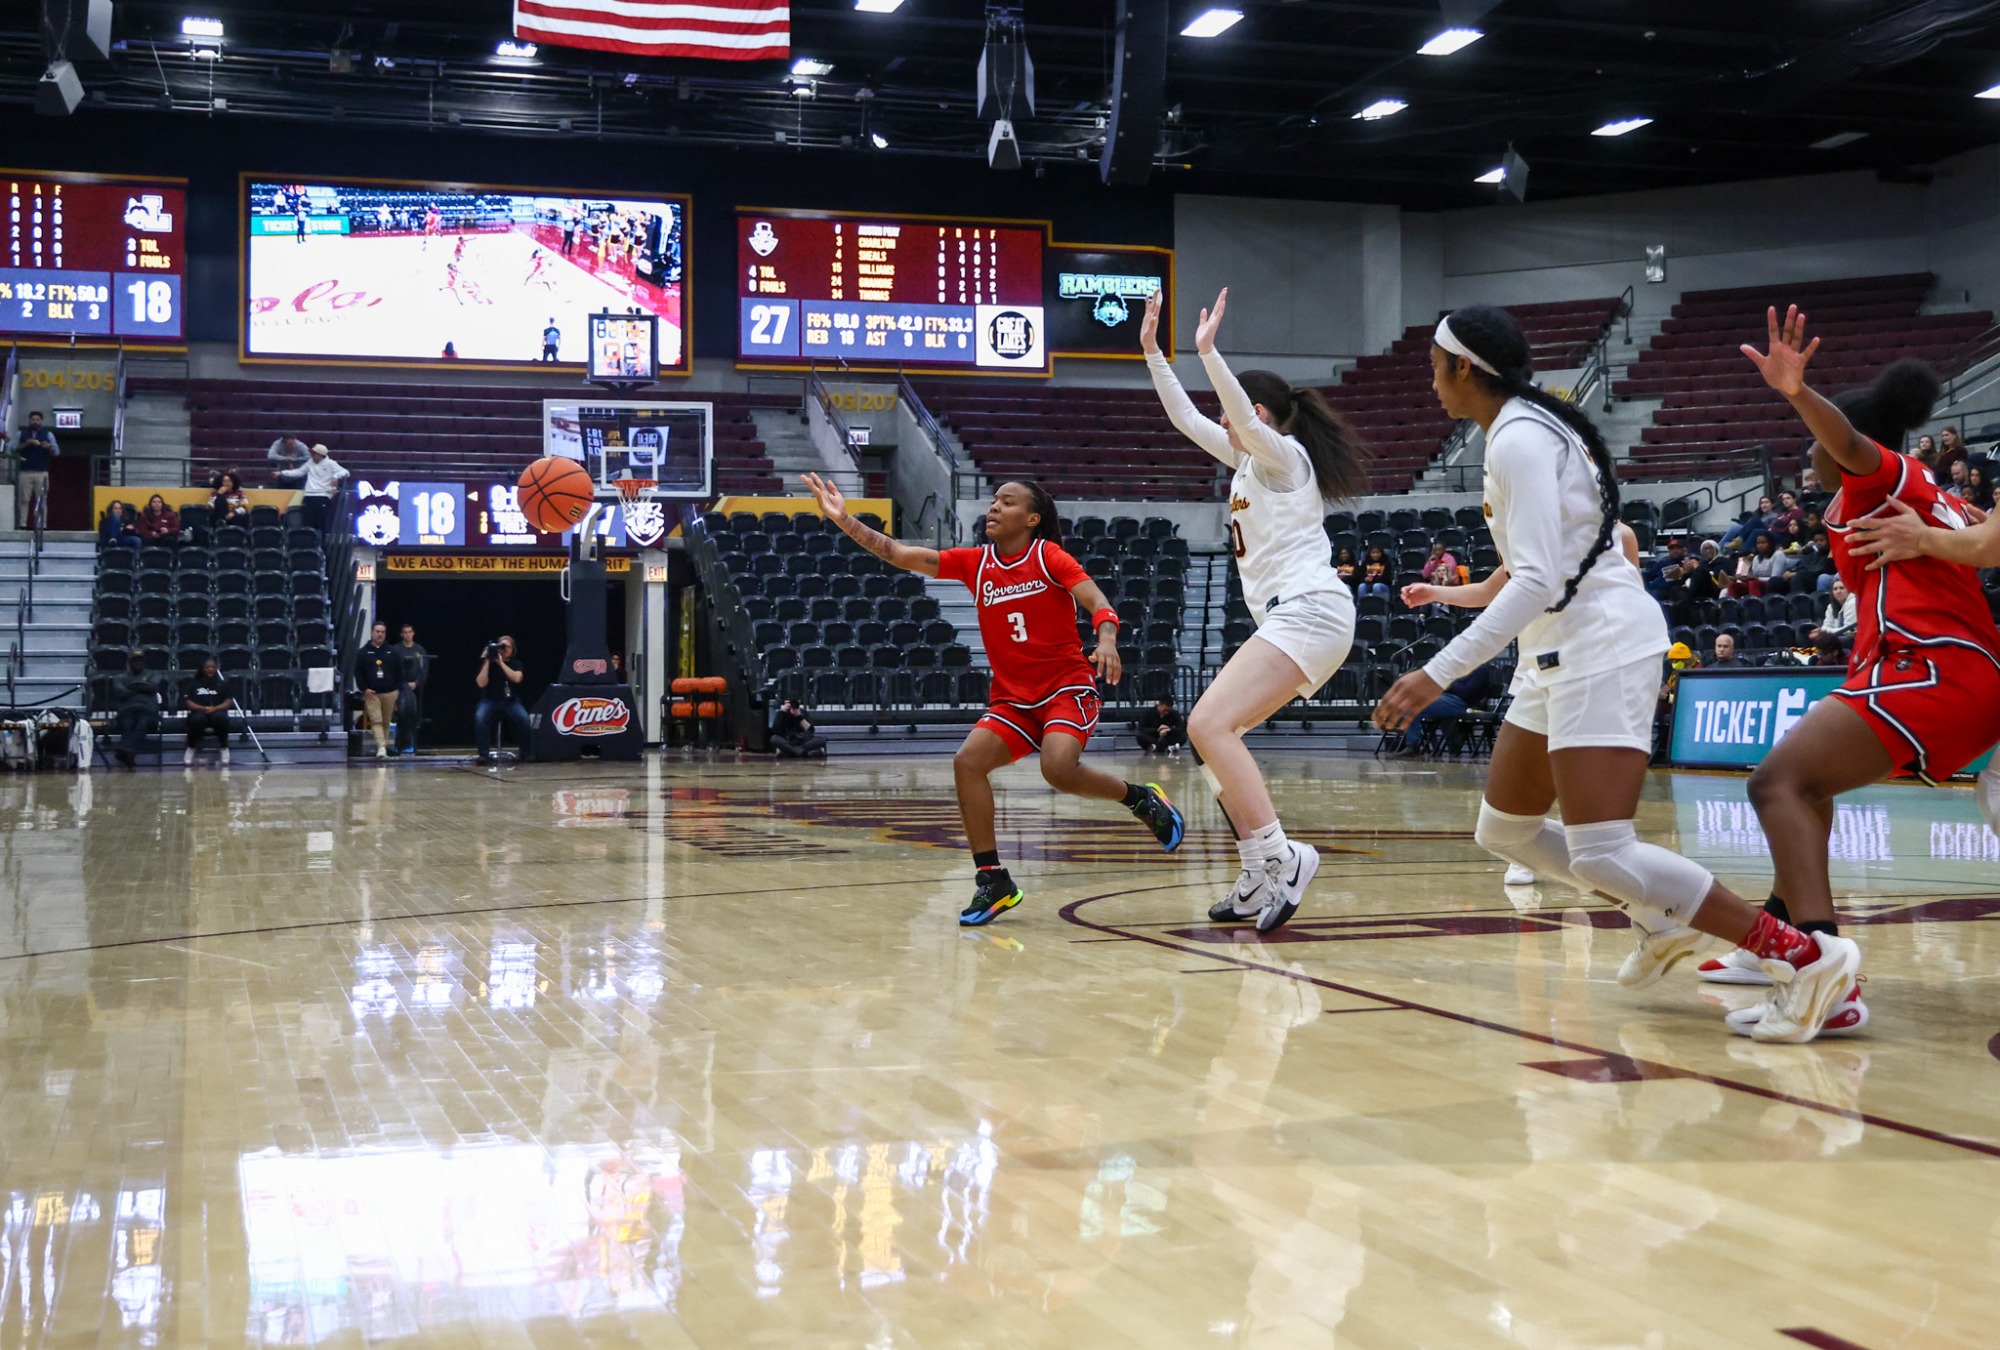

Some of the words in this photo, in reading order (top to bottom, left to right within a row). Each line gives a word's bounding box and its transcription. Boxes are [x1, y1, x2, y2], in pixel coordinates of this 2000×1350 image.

[34, 184, 41, 194] A
[55, 185, 62, 195] F
[35, 198, 42, 209] 1
[53, 198, 62, 210] 2
[12, 225, 20, 237] 2
[54, 228, 62, 240] 3
[939, 227, 945, 237] P
[974, 229, 980, 239] A
[990, 229, 996, 240] F
[11, 241, 20, 252] 4
[836, 236, 843, 247] 3
[939, 240, 945, 251] 1
[959, 241, 965, 252] 3
[974, 241, 980, 252] 4
[990, 242, 996, 253] 1
[13, 255, 20, 266] 1
[35, 256, 42, 267] 1
[55, 257, 62, 268] 1
[140, 255, 170, 268] FOULS
[835, 249, 842, 259] 4
[959, 254, 965, 265] 4
[990, 255, 996, 266] 1
[748, 265, 757, 278] 4
[831, 262, 842, 273] 15
[858, 263, 895, 275] WILLIAMS
[960, 267, 965, 278] 1
[974, 268, 980, 279] 2
[989, 268, 996, 279] 2
[15, 283, 45, 300] 18.2
[48, 284, 77, 301] FT%
[760, 281, 786, 293] FOULS
[830, 276, 842, 287] 24
[959, 280, 965, 291] 2
[975, 281, 980, 292] 1
[989, 281, 996, 293] 2
[1061, 275, 1161, 296] RAMBLERS
[128, 280, 172, 323] 18
[831, 289, 843, 300] 34
[959, 292, 966, 304] 4
[991, 294, 997, 305] 1
[22, 301, 33, 318] 2
[48, 303, 74, 319] BLK
[89, 304, 99, 320] 3
[750, 304, 790, 345] 27
[807, 313, 832, 329] FG%
[865, 315, 896, 330] 3PT%
[925, 316, 948, 332] FT%
[996, 317, 1026, 333] GREAT
[806, 329, 829, 345] REB
[866, 331, 887, 346] AST
[925, 333, 946, 349] BLK
[997, 333, 1026, 349] LAKES
[60, 415, 77, 426] EXIT
[413, 492, 455, 534] 18
[393, 558, 415, 568] WE
[420, 558, 453, 568] ALSO
[458, 558, 497, 568] TREAT
[502, 558, 525, 569] THE
[529, 558, 568, 569] HUMA
[649, 567, 664, 577] EXIT
[983, 580, 1048, 607] Governors
[1007, 612, 1028, 642] 3
[557, 698, 627, 732] Cane's
[1694, 701, 1773, 743] TICKET
